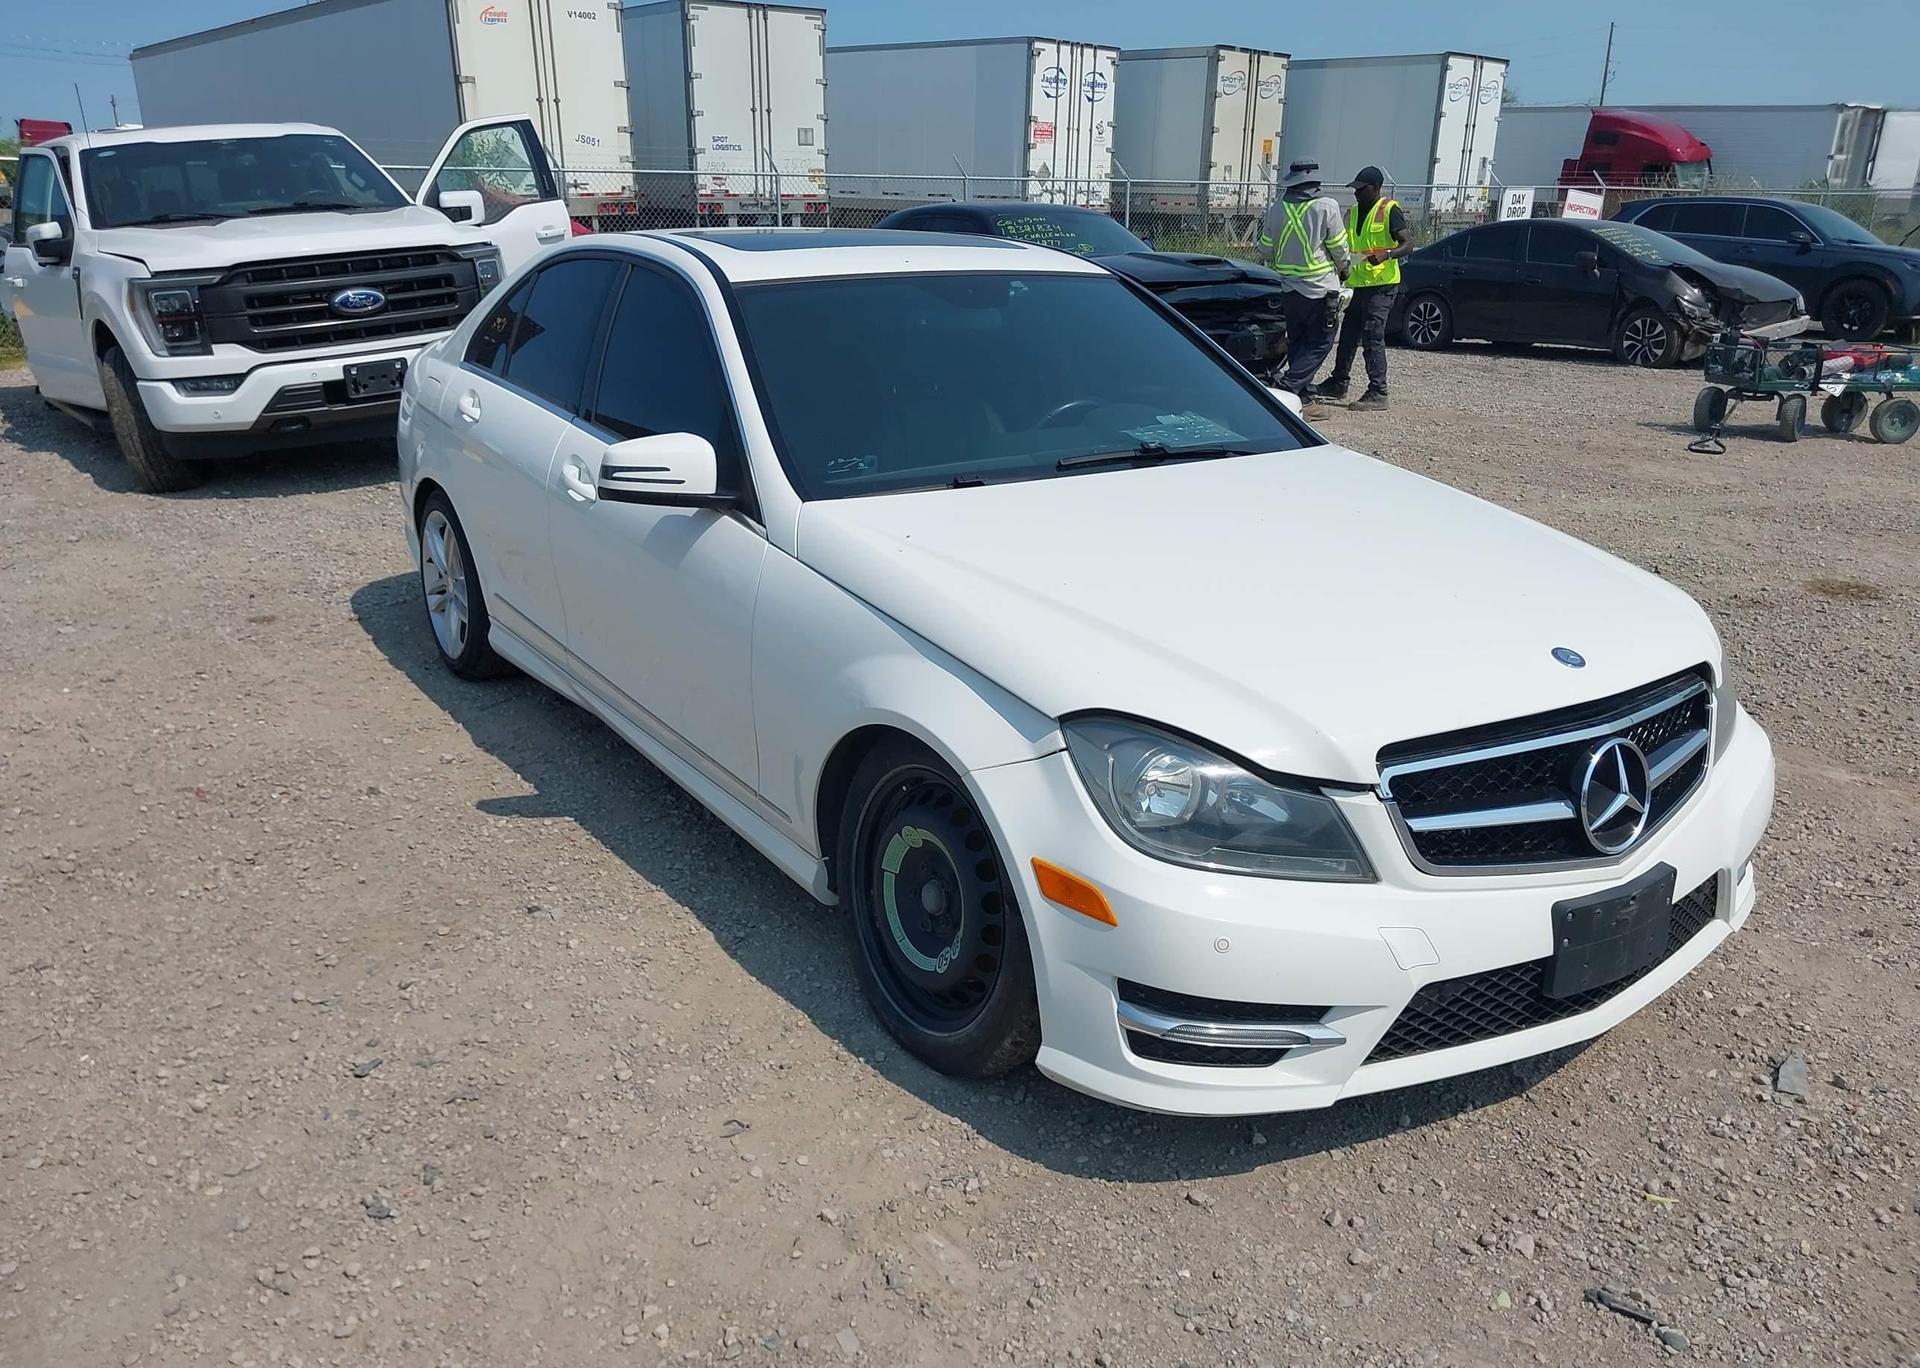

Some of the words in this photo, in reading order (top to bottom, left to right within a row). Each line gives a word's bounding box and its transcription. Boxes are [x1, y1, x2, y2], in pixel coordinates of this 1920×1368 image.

[567, 11, 597, 20] V14002
[575, 133, 600, 147] JS051
[1511, 193, 1526, 205] DAY
[1506, 205, 1527, 218] DROP
[1566, 202, 1600, 216] INSPECTION
[348, 294, 374, 307] Ford
